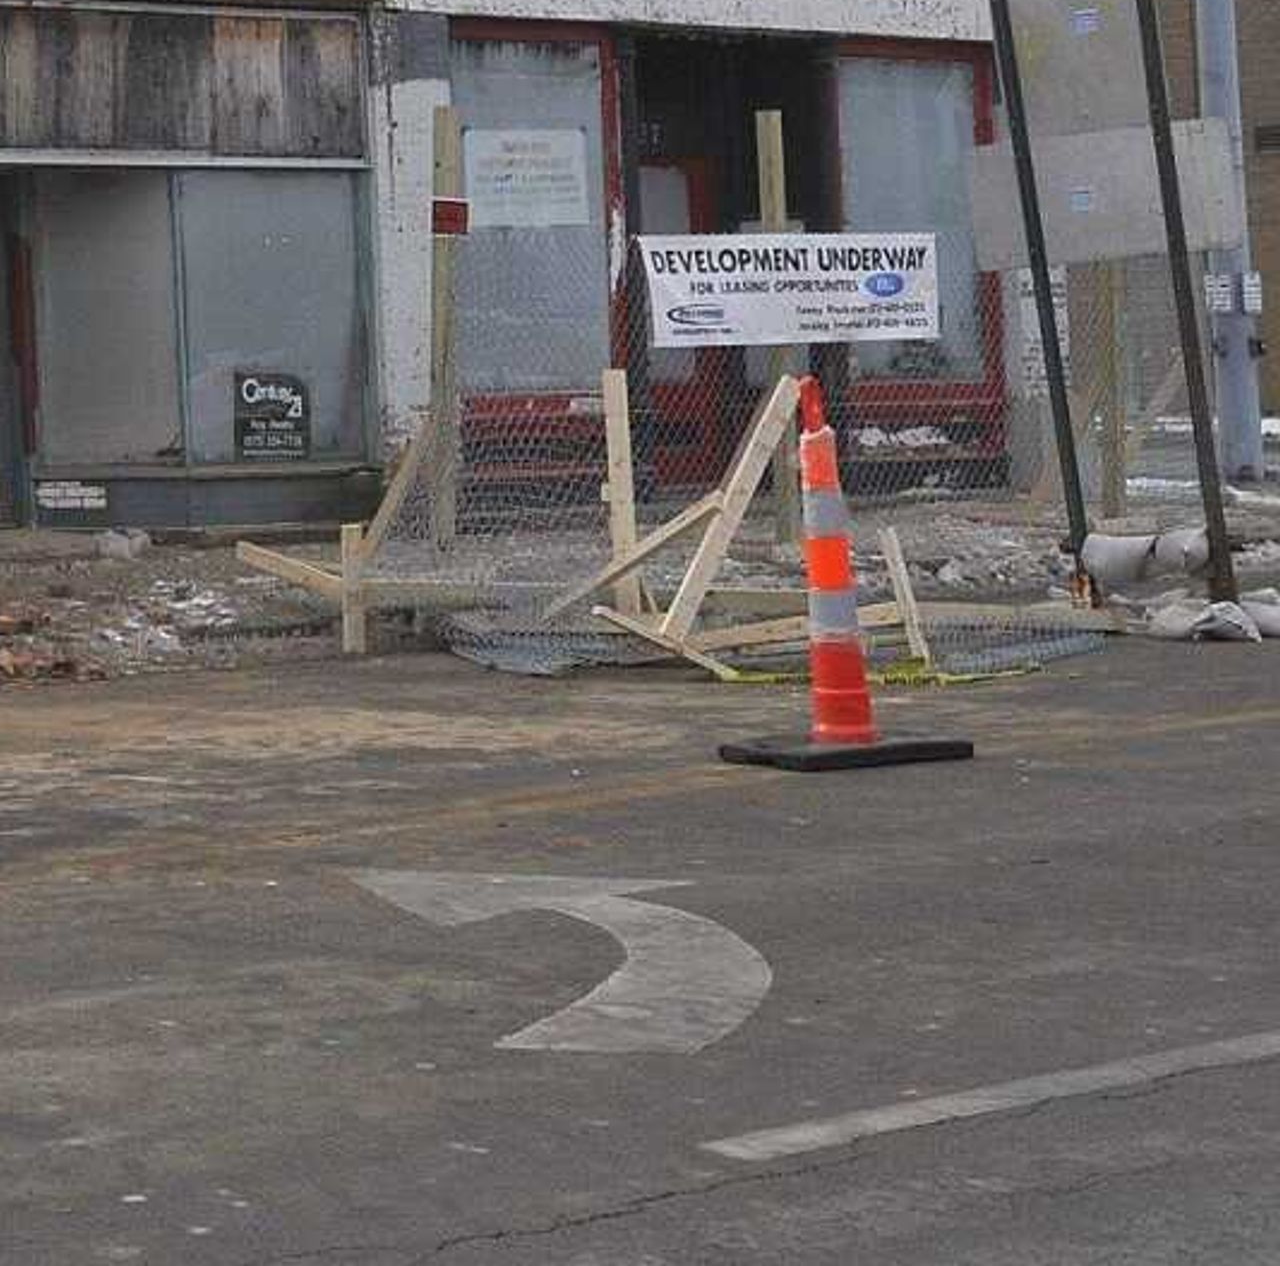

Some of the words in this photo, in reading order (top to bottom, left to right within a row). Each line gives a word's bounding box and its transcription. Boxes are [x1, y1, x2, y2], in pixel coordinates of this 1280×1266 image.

[650, 248, 808, 274] DEVELOPMENT
[816, 247, 927, 272] UNDERWAY
[689, 279, 714, 295] FOR
[720, 279, 769, 294] LEASING
[285, 394, 303, 417] 21
